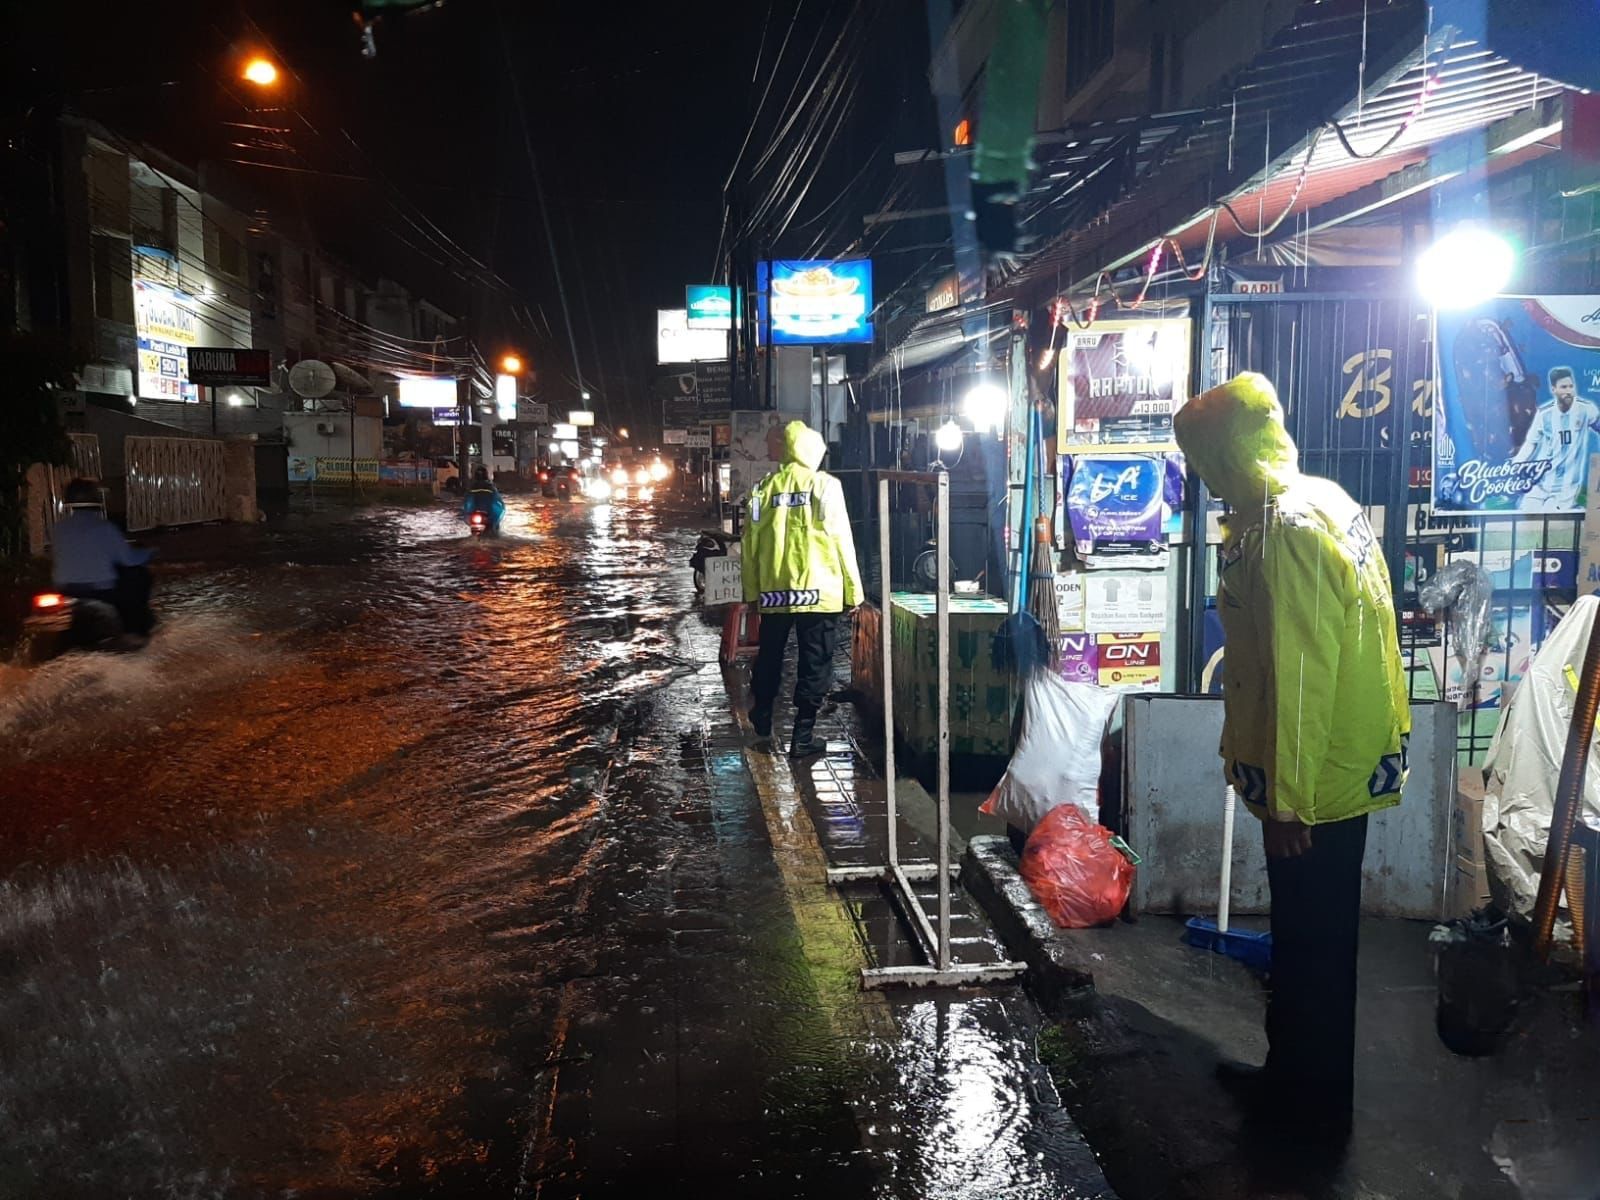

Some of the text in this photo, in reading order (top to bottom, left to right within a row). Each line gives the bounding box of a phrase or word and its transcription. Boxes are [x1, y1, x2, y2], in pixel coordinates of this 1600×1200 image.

[192, 352, 237, 371] KARUNIA
[1089, 375, 1160, 398] RAPTOR
[1558, 430, 1572, 445] 10
[1458, 459, 1549, 489] Blueberry
[1120, 494, 1139, 502] ICE
[1470, 475, 1533, 504] Cookies
[1105, 644, 1150, 660] ON
